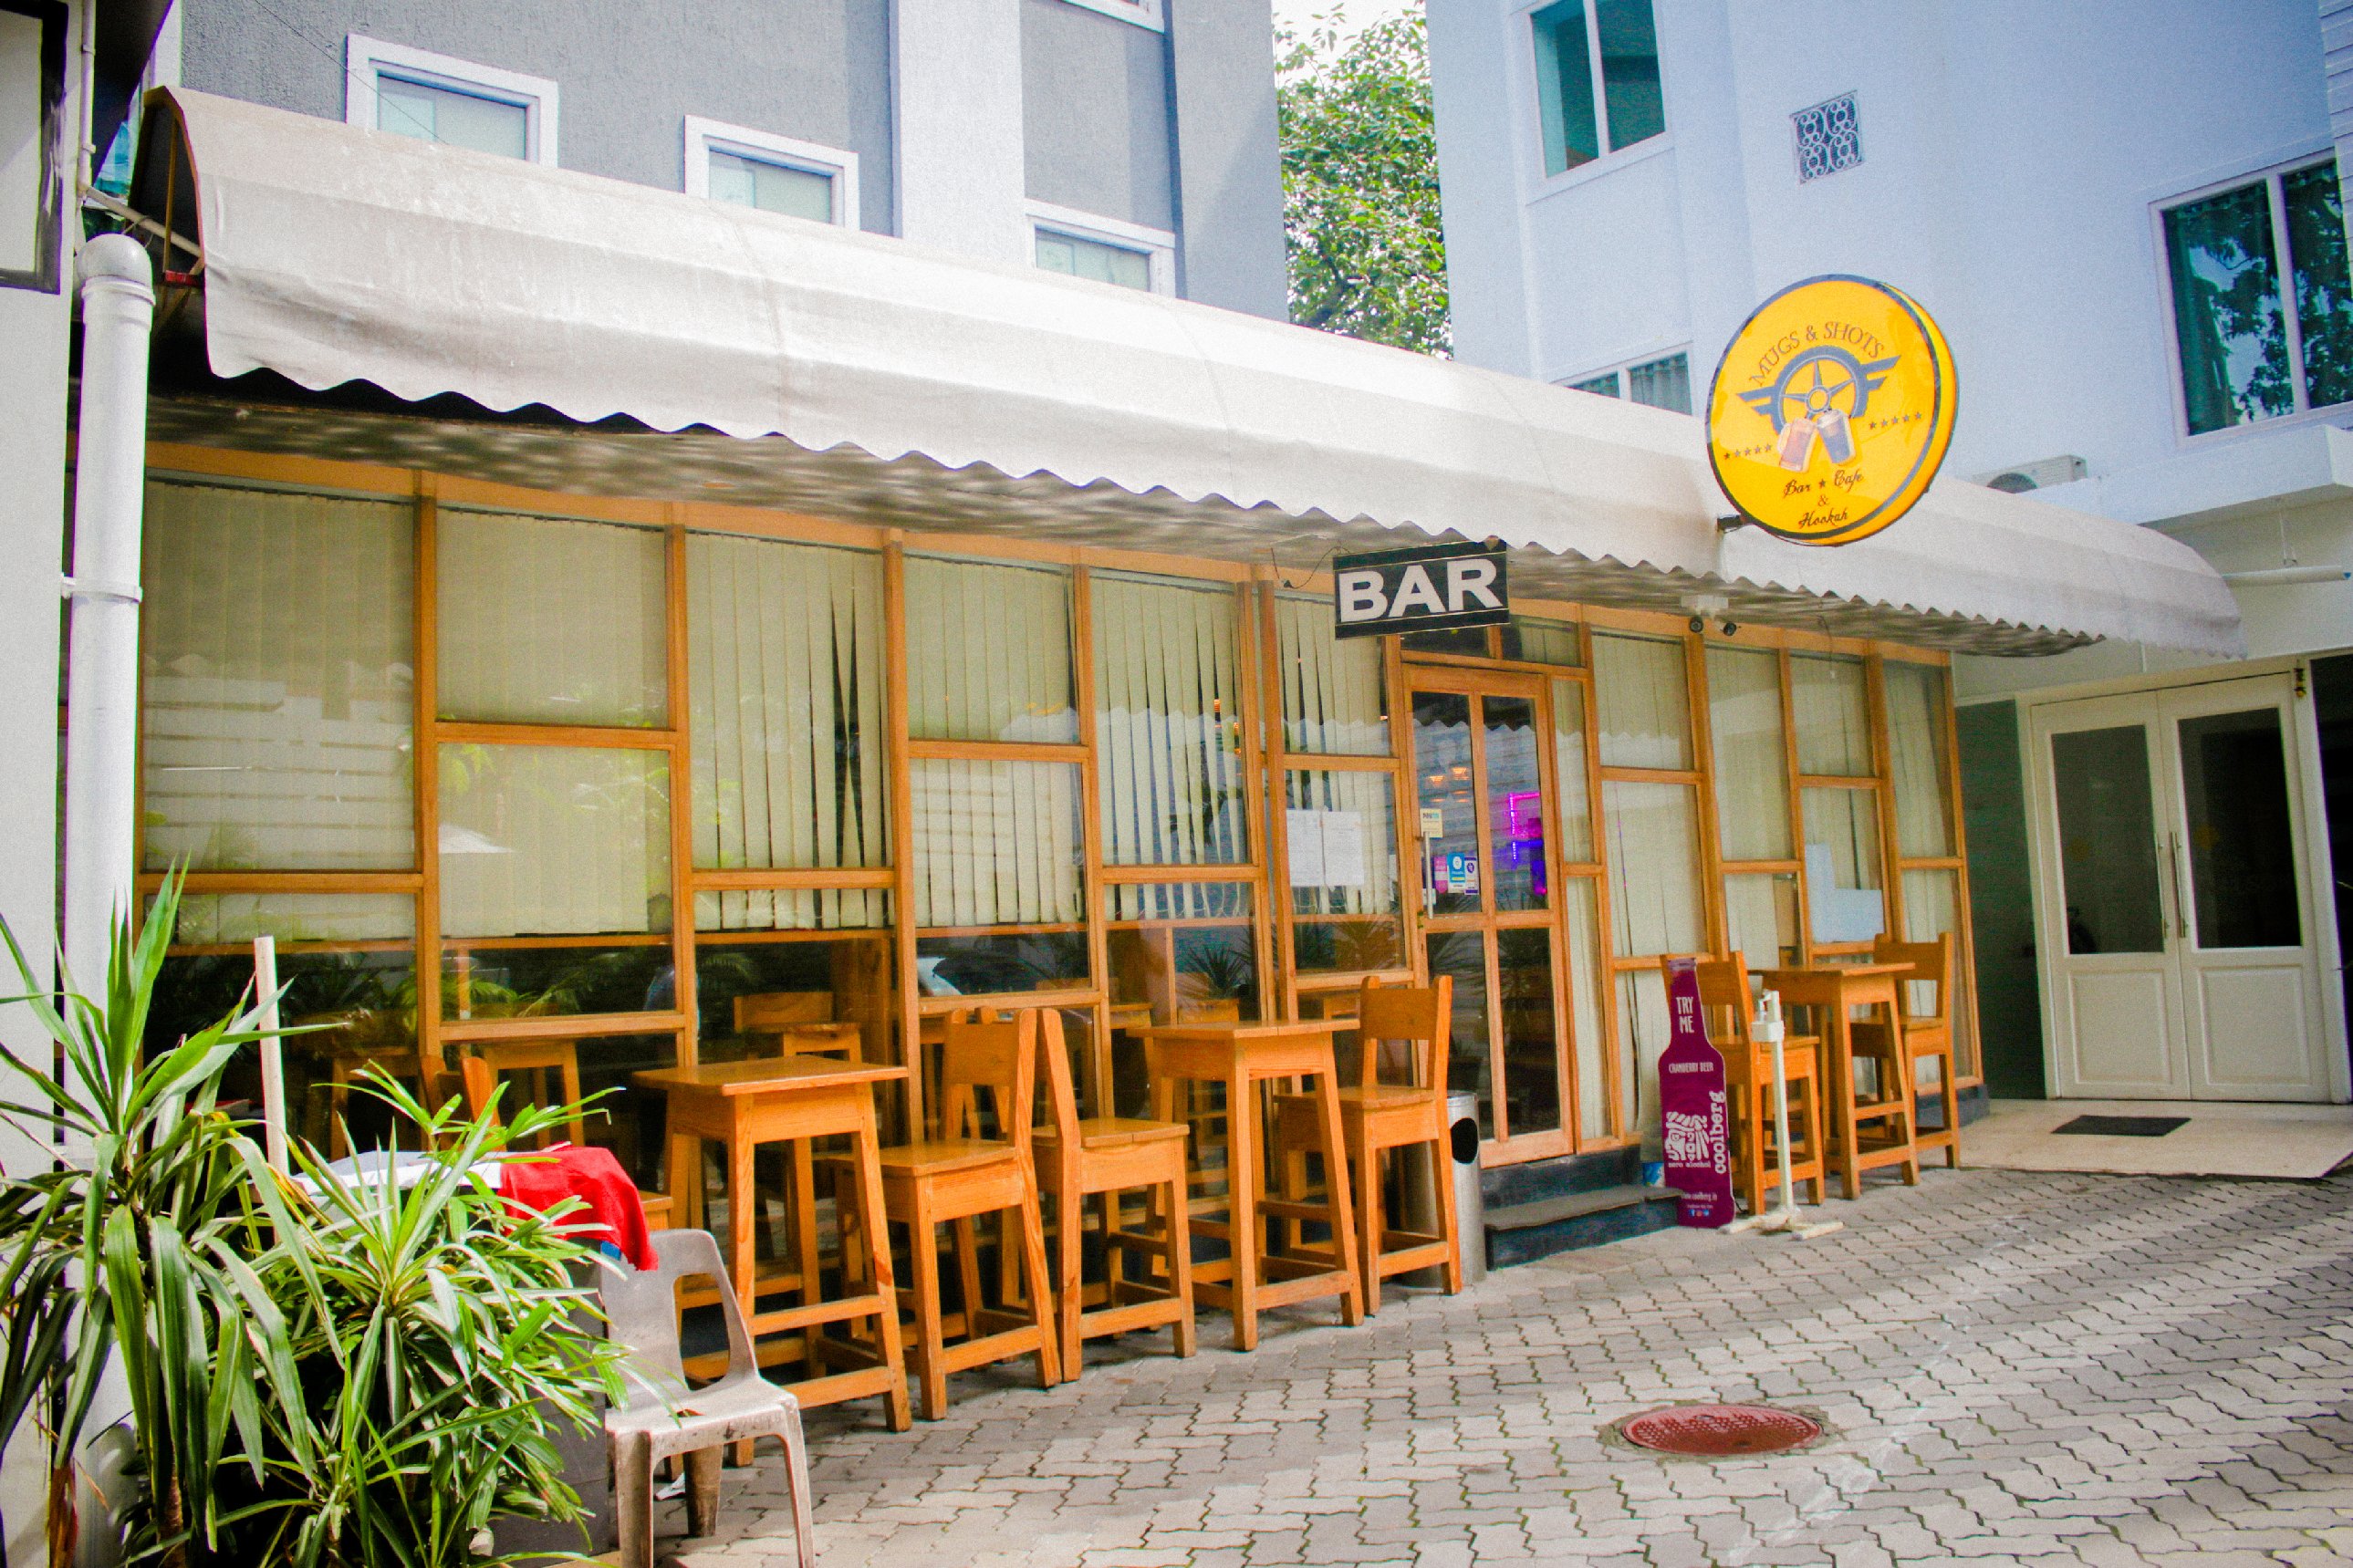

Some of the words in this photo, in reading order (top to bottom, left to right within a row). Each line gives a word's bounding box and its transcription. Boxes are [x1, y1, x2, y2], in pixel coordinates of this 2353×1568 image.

[1748, 330, 1800, 387] MUGS
[1806, 325, 1817, 342] &
[1824, 321, 1884, 358] SHOTS
[1784, 479, 1811, 498] Bar
[1834, 468, 1864, 493] Cafe
[1817, 494, 1829, 506] &
[1798, 507, 1848, 529] Hookah
[1338, 558, 1504, 623] BAR
[1675, 996, 1694, 1015] TRY
[1679, 1015, 1695, 1033] ME
[1668, 1062, 1699, 1074] CRANBERRY
[1700, 1062, 1714, 1073] BEER
[1708, 1090, 1727, 1175] coolberg
